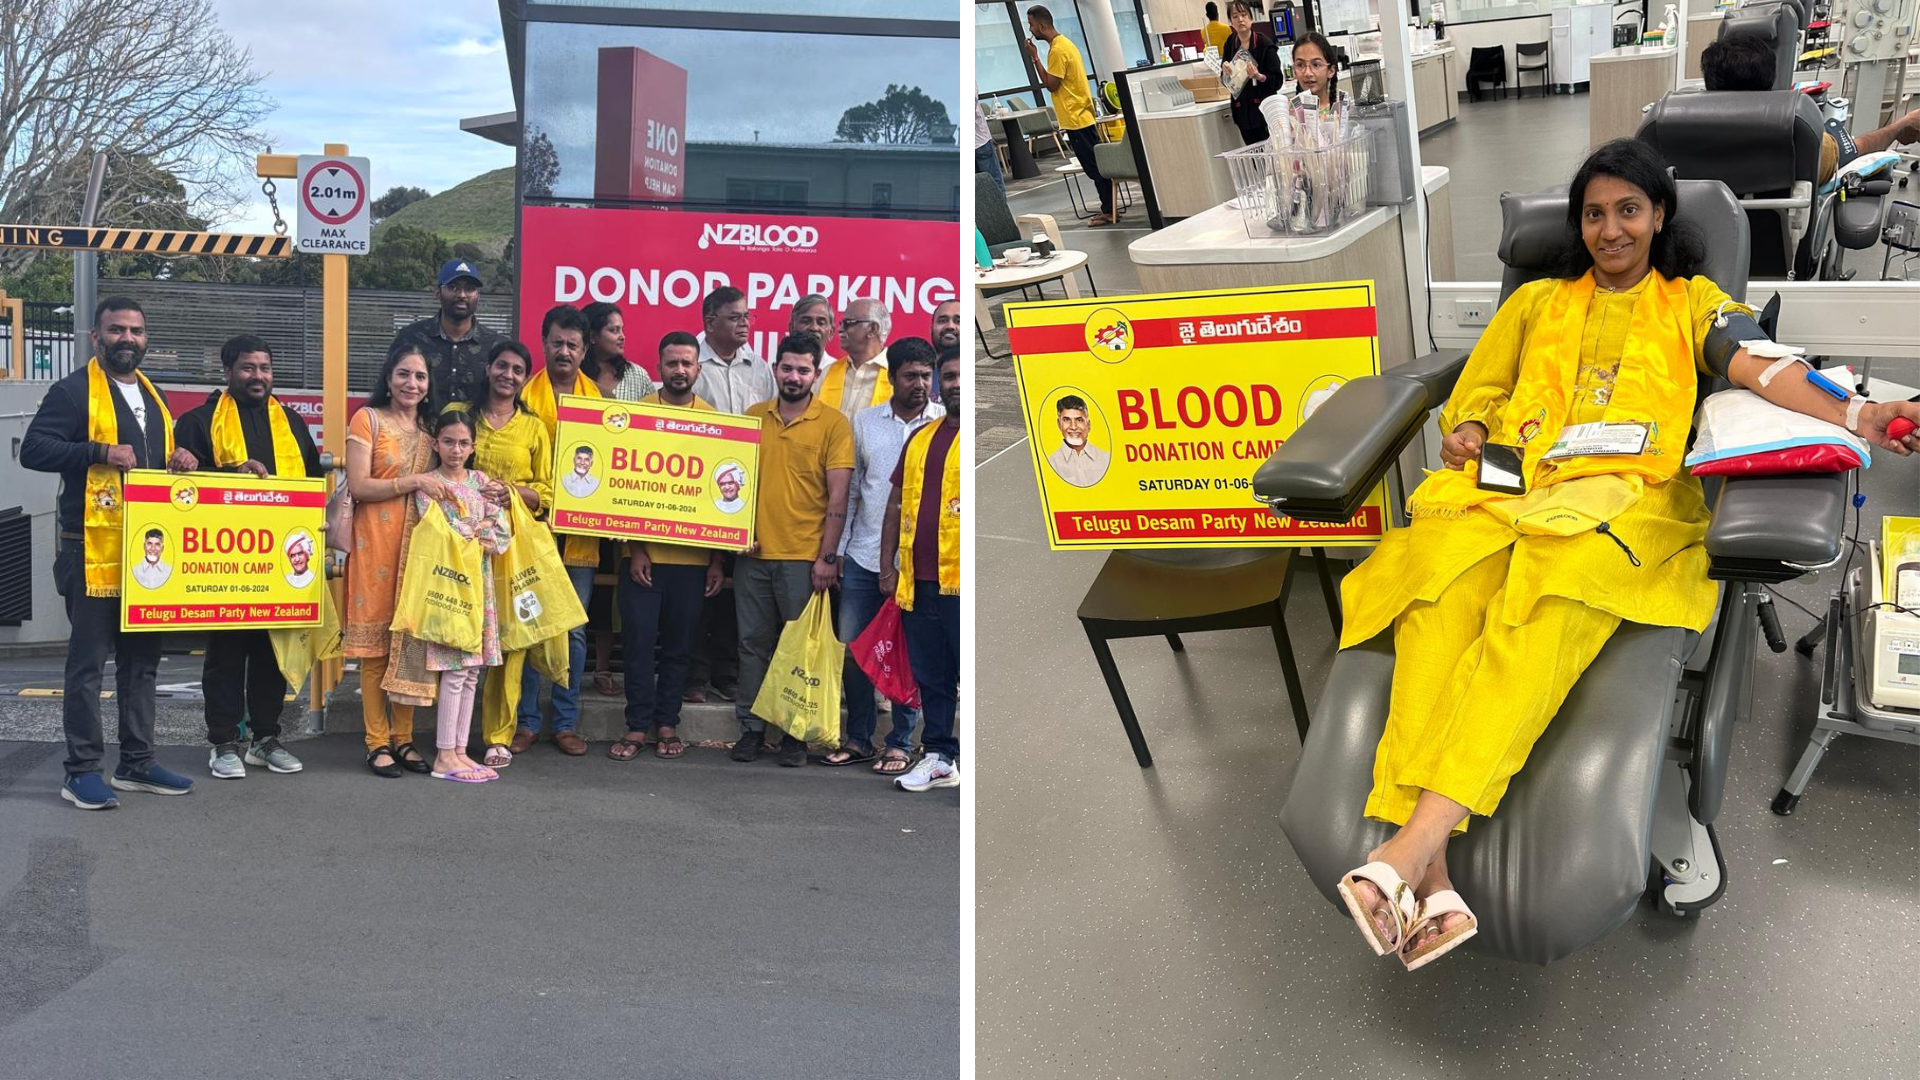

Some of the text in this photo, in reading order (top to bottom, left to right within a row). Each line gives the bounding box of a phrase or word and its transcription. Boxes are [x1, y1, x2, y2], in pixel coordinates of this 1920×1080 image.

[311, 186, 356, 199] 2.01m
[321, 229, 346, 238] MAX
[699, 223, 819, 249] NZBLOOD
[302, 239, 366, 250] CLEARANCE
[1200, 315, 1301, 338] తెలుగుదేశం
[280, 401, 323, 415] ZBLO
[1117, 384, 1282, 430] BLOOD
[1125, 441, 1225, 463] DONATION
[611, 447, 704, 479] BLOOD
[609, 477, 702, 497] DONATION CAMP
[1138, 478, 1253, 491] SATURDAY 01-06-
[612, 498, 696, 513] SATURDAY 01-06-2024
[566, 513, 740, 541] Telugu Desam Party New Zealand
[1072, 515, 1131, 535] Telugu
[1138, 514, 1195, 531] Desam
[1202, 513, 1247, 533] Party
[1254, 512, 1291, 529] New
[182, 527, 274, 554] BLOOD
[182, 562, 274, 574] DONATION CAMP
[432, 564, 471, 585] NZBLO
[515, 566, 537, 581] LIVES
[185, 585, 269, 593] SATURDAY 01-06-2024
[513, 575, 541, 592] PLASMA
[140, 606, 312, 621] Telugu Desam Party New Zealand
